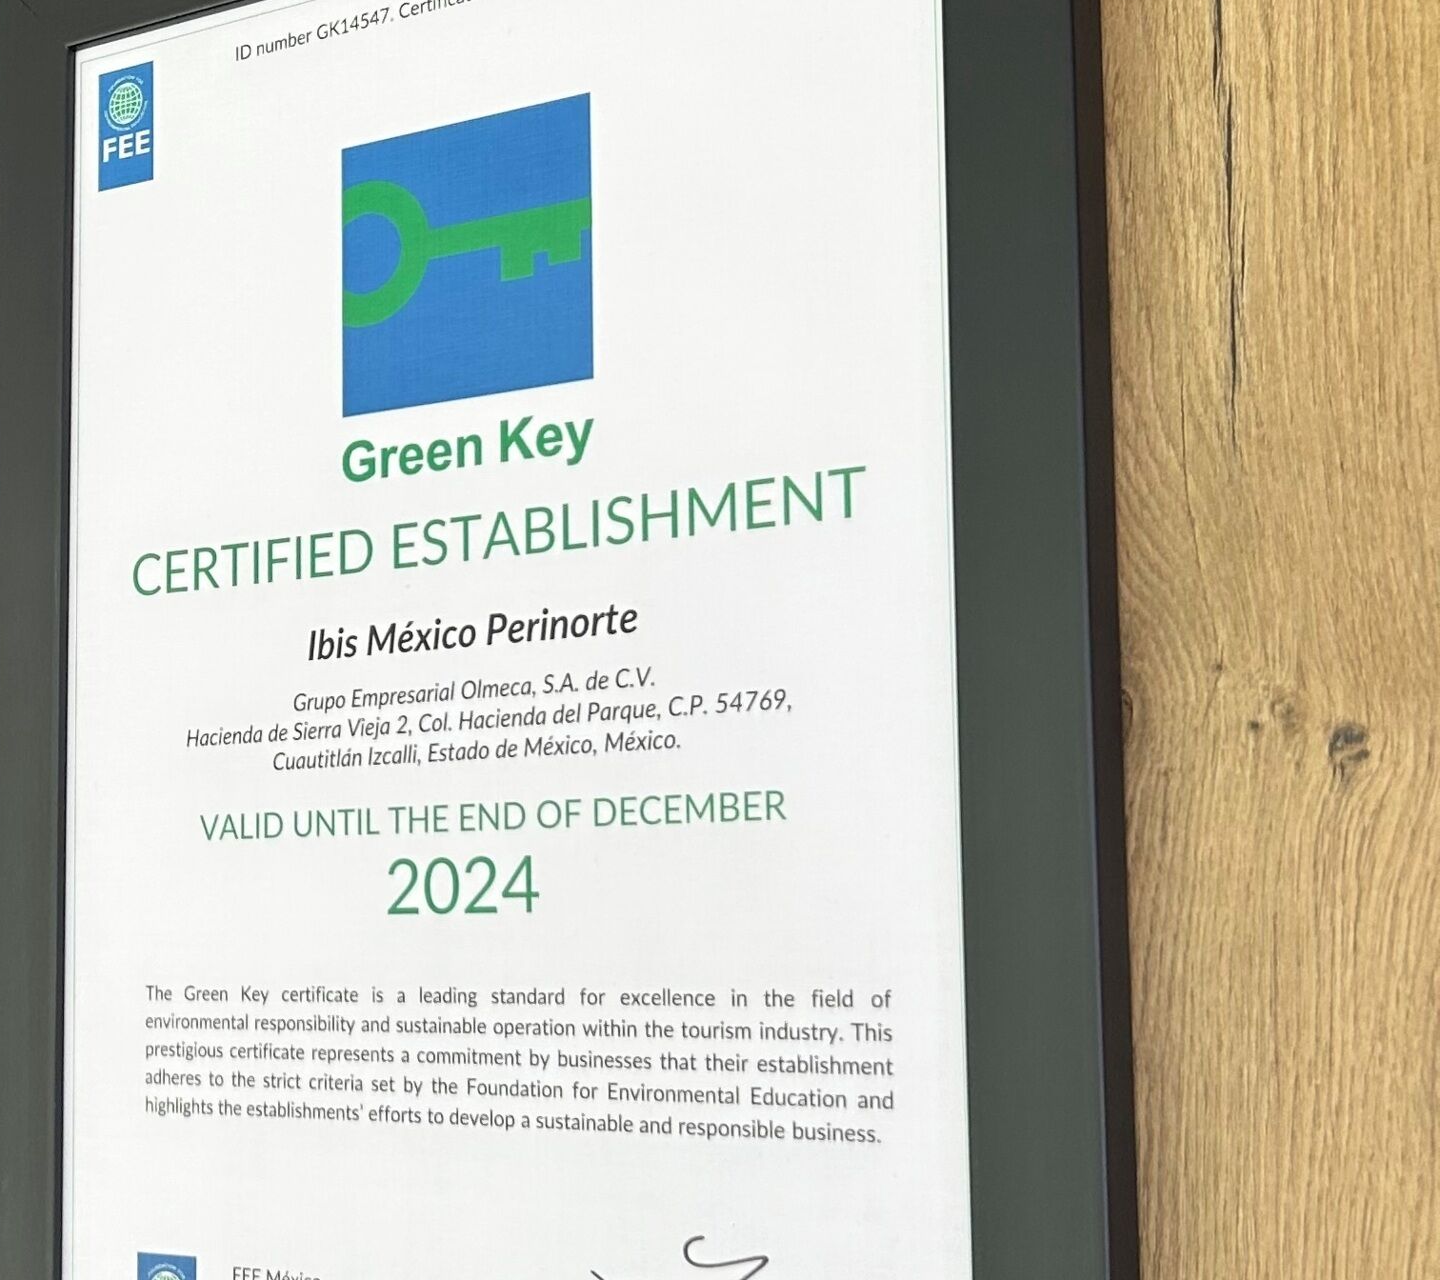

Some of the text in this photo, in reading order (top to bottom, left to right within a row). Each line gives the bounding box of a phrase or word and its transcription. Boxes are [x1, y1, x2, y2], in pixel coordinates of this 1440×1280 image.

[235, 43, 252, 62] ID
[256, 30, 313, 57] number
[316, 6, 395, 40] GK14547.
[102, 129, 151, 163] FEE
[341, 414, 595, 483] Green Key
[132, 465, 867, 597] CERTIFIED ESTABLISHMENT
[307, 603, 639, 662] Ibis México Perinorte
[293, 665, 656, 715] Grupo Empresarial Olmeca, S.A. de C.V.
[186, 688, 793, 748] Hacienda de Sierra Vieja 2, Col. Hacienda del Parque, C.P. 54769,
[272, 729, 681, 772] Cuautitlán Izcalli, Estado de México, México.
[199, 789, 788, 842] VALID UNTIL THE END OF DECEMBER
[386, 854, 541, 916] 2024
[144, 984, 893, 1009] The Green Key certificate is a leading standard for excellence in the field of
[144, 1012, 893, 1046] environmental responsibility and sustainable operation within the tourism industry. This
[145, 1040, 895, 1077] prestigious certificate represents a commitment by businesses that their establishment
[144, 1067, 895, 1111] adheres to the strict criteria set by the Foundation for Environmental Education and
[145, 1095, 214, 1119] highlights
[217, 1098, 242, 1117] the
[367, 1104, 422, 1125] efforts
[426, 1107, 445, 1126] to
[448, 1107, 516, 1132] develop
[520, 1114, 531, 1129] a
[535, 1112, 634, 1134] sustainable
[638, 1115, 673, 1136] and
[678, 1118, 786, 1141] responsible
[791, 1120, 882, 1144] business.
